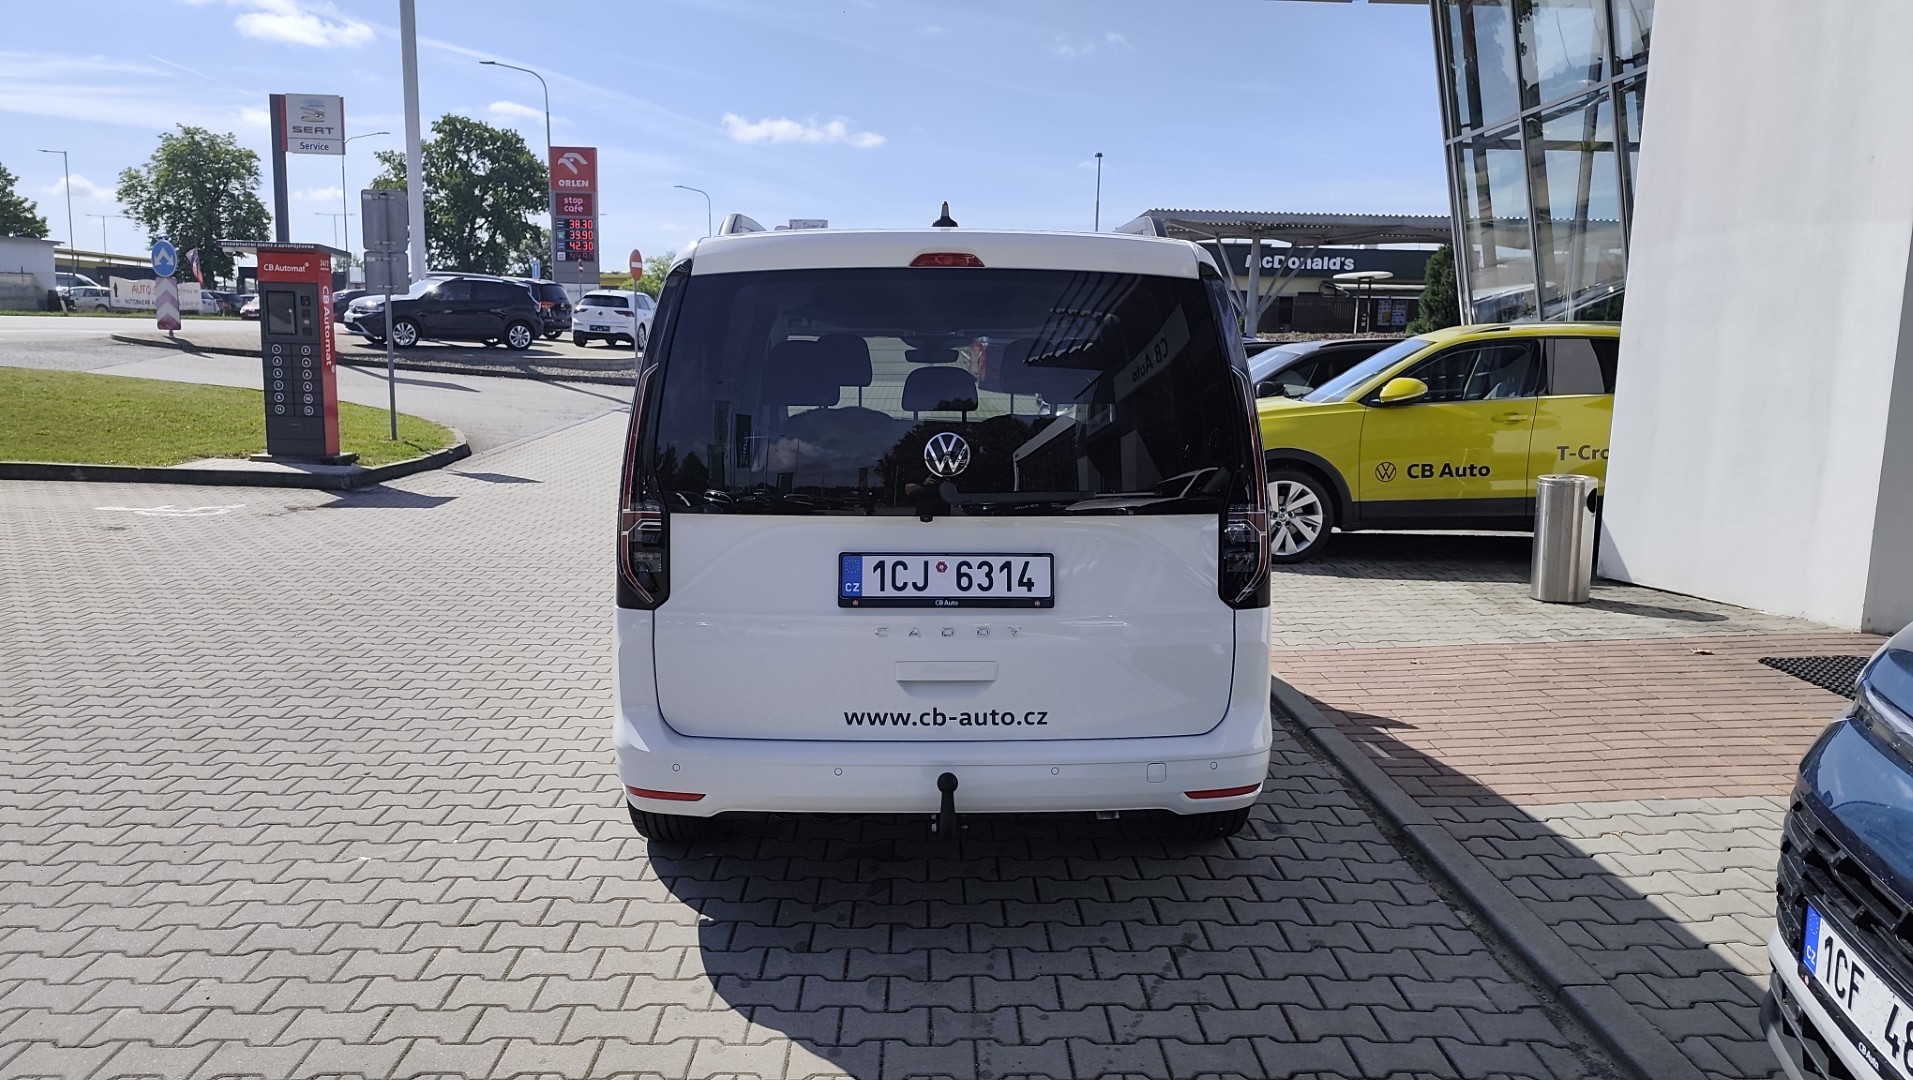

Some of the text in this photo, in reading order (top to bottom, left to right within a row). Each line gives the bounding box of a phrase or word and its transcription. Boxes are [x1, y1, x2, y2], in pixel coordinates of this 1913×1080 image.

[292, 126, 334, 134] SEAT
[300, 141, 330, 151] Service
[558, 179, 589, 187] ORLEN
[563, 197, 584, 206] stop
[563, 205, 584, 213] cafe
[569, 220, 593, 229] 38.30
[569, 231, 594, 240] 39.90
[569, 241, 594, 250] 42.30
[263, 263, 306, 272] CB Automat
[132, 284, 151, 294] AUTO
[322, 285, 332, 366] CB Automat
[1406, 463, 1434, 479] CB
[1438, 462, 1491, 478] Auto
[845, 560, 1035, 592] CZ 1CJ 6314
[874, 627, 1021, 637] CADDY
[844, 707, 1048, 727] www.cb-auto.cz
[1806, 944, 1816, 966] CZ
[1824, 935, 1865, 1011] 1CF
[1858, 1041, 1879, 1072] CB Auto
